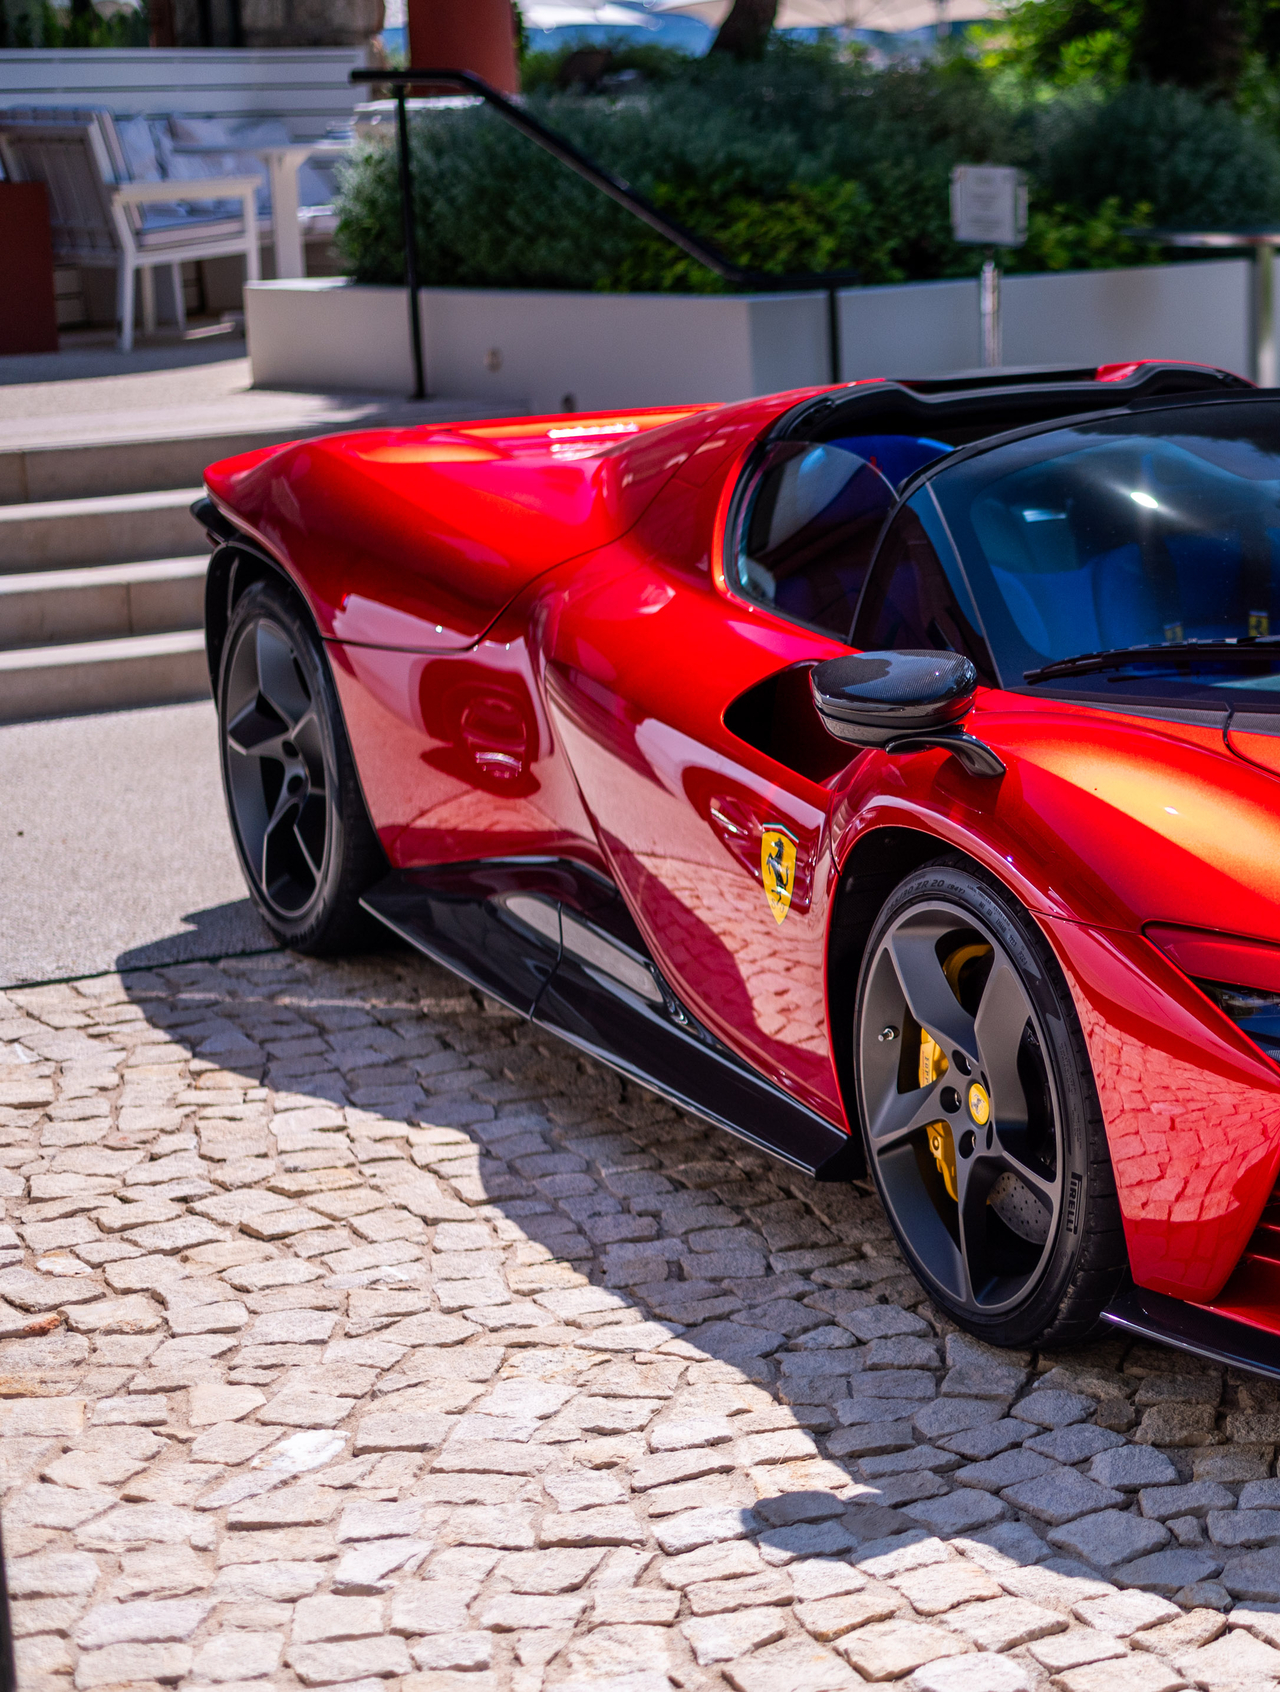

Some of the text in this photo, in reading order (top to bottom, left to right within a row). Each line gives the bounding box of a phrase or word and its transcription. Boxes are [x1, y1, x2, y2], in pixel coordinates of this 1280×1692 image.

[915, 880, 928, 890] ZR
[930, 879, 945, 888] 20
[1065, 1171, 1083, 1235] PIRELLI
